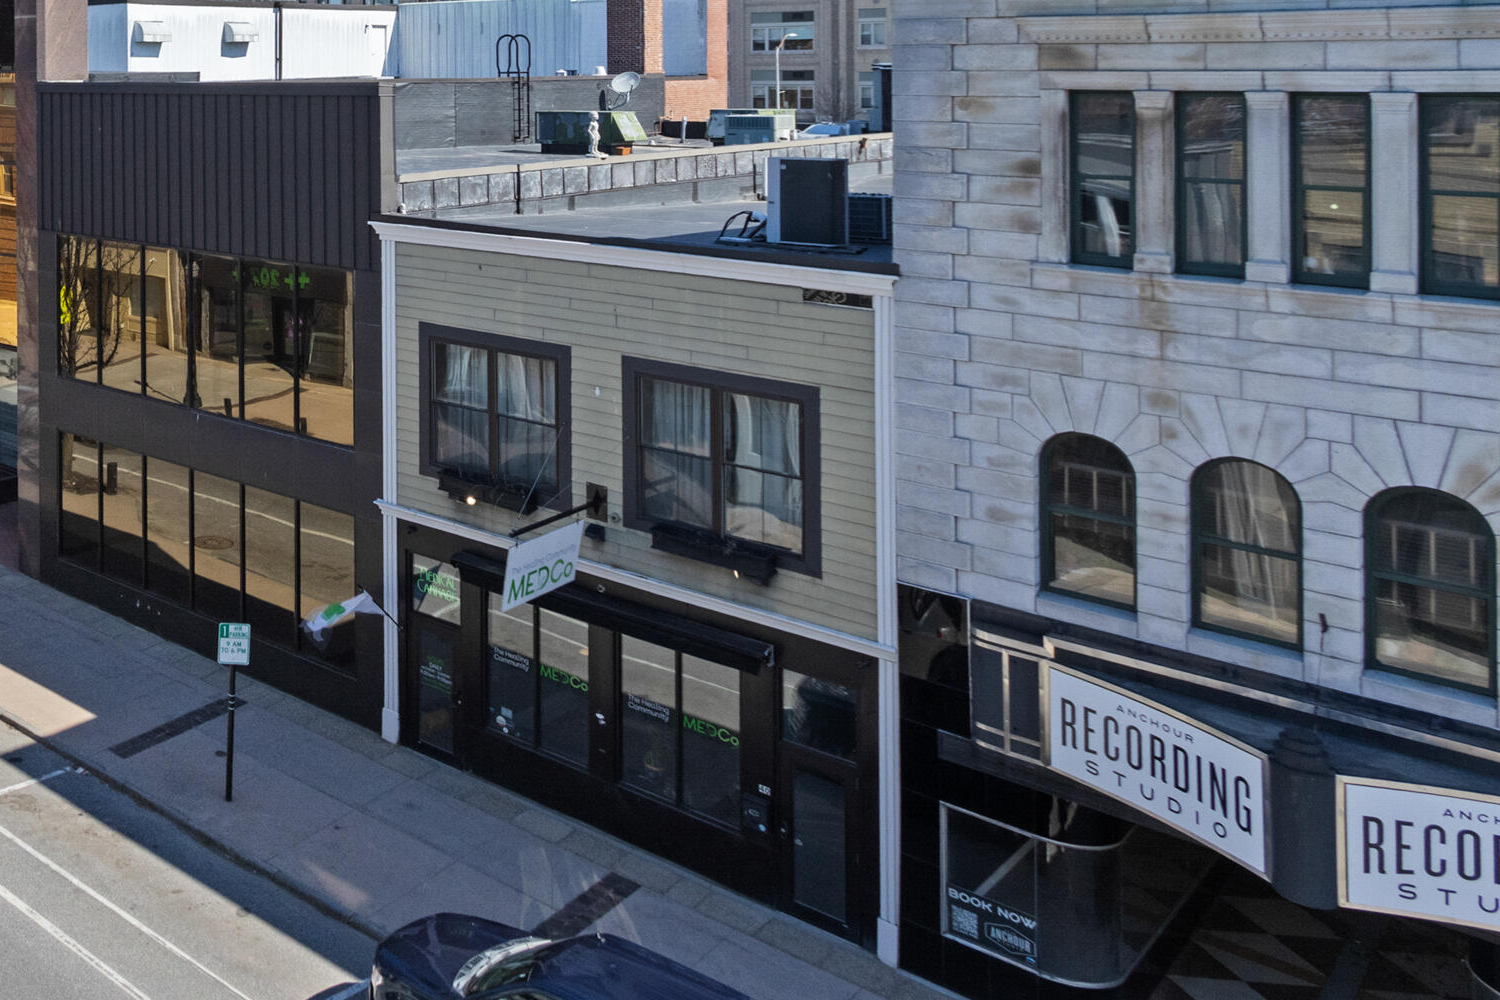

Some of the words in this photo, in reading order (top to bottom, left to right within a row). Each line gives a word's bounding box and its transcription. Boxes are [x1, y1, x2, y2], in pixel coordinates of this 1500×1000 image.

[493, 653, 529, 672] Community
[505, 650, 530, 666] Healing
[628, 702, 670, 723] Community
[641, 697, 670, 714] Healing
[1116, 704, 1194, 744] ANCHOUR
[1061, 697, 1253, 836] RECORDING
[1085, 759, 1228, 839] STUDIO
[1362, 815, 1500, 885] RECO
[948, 887, 993, 913] BOOK
[997, 906, 1037, 930] NOW
[1398, 883, 1500, 914] STU
